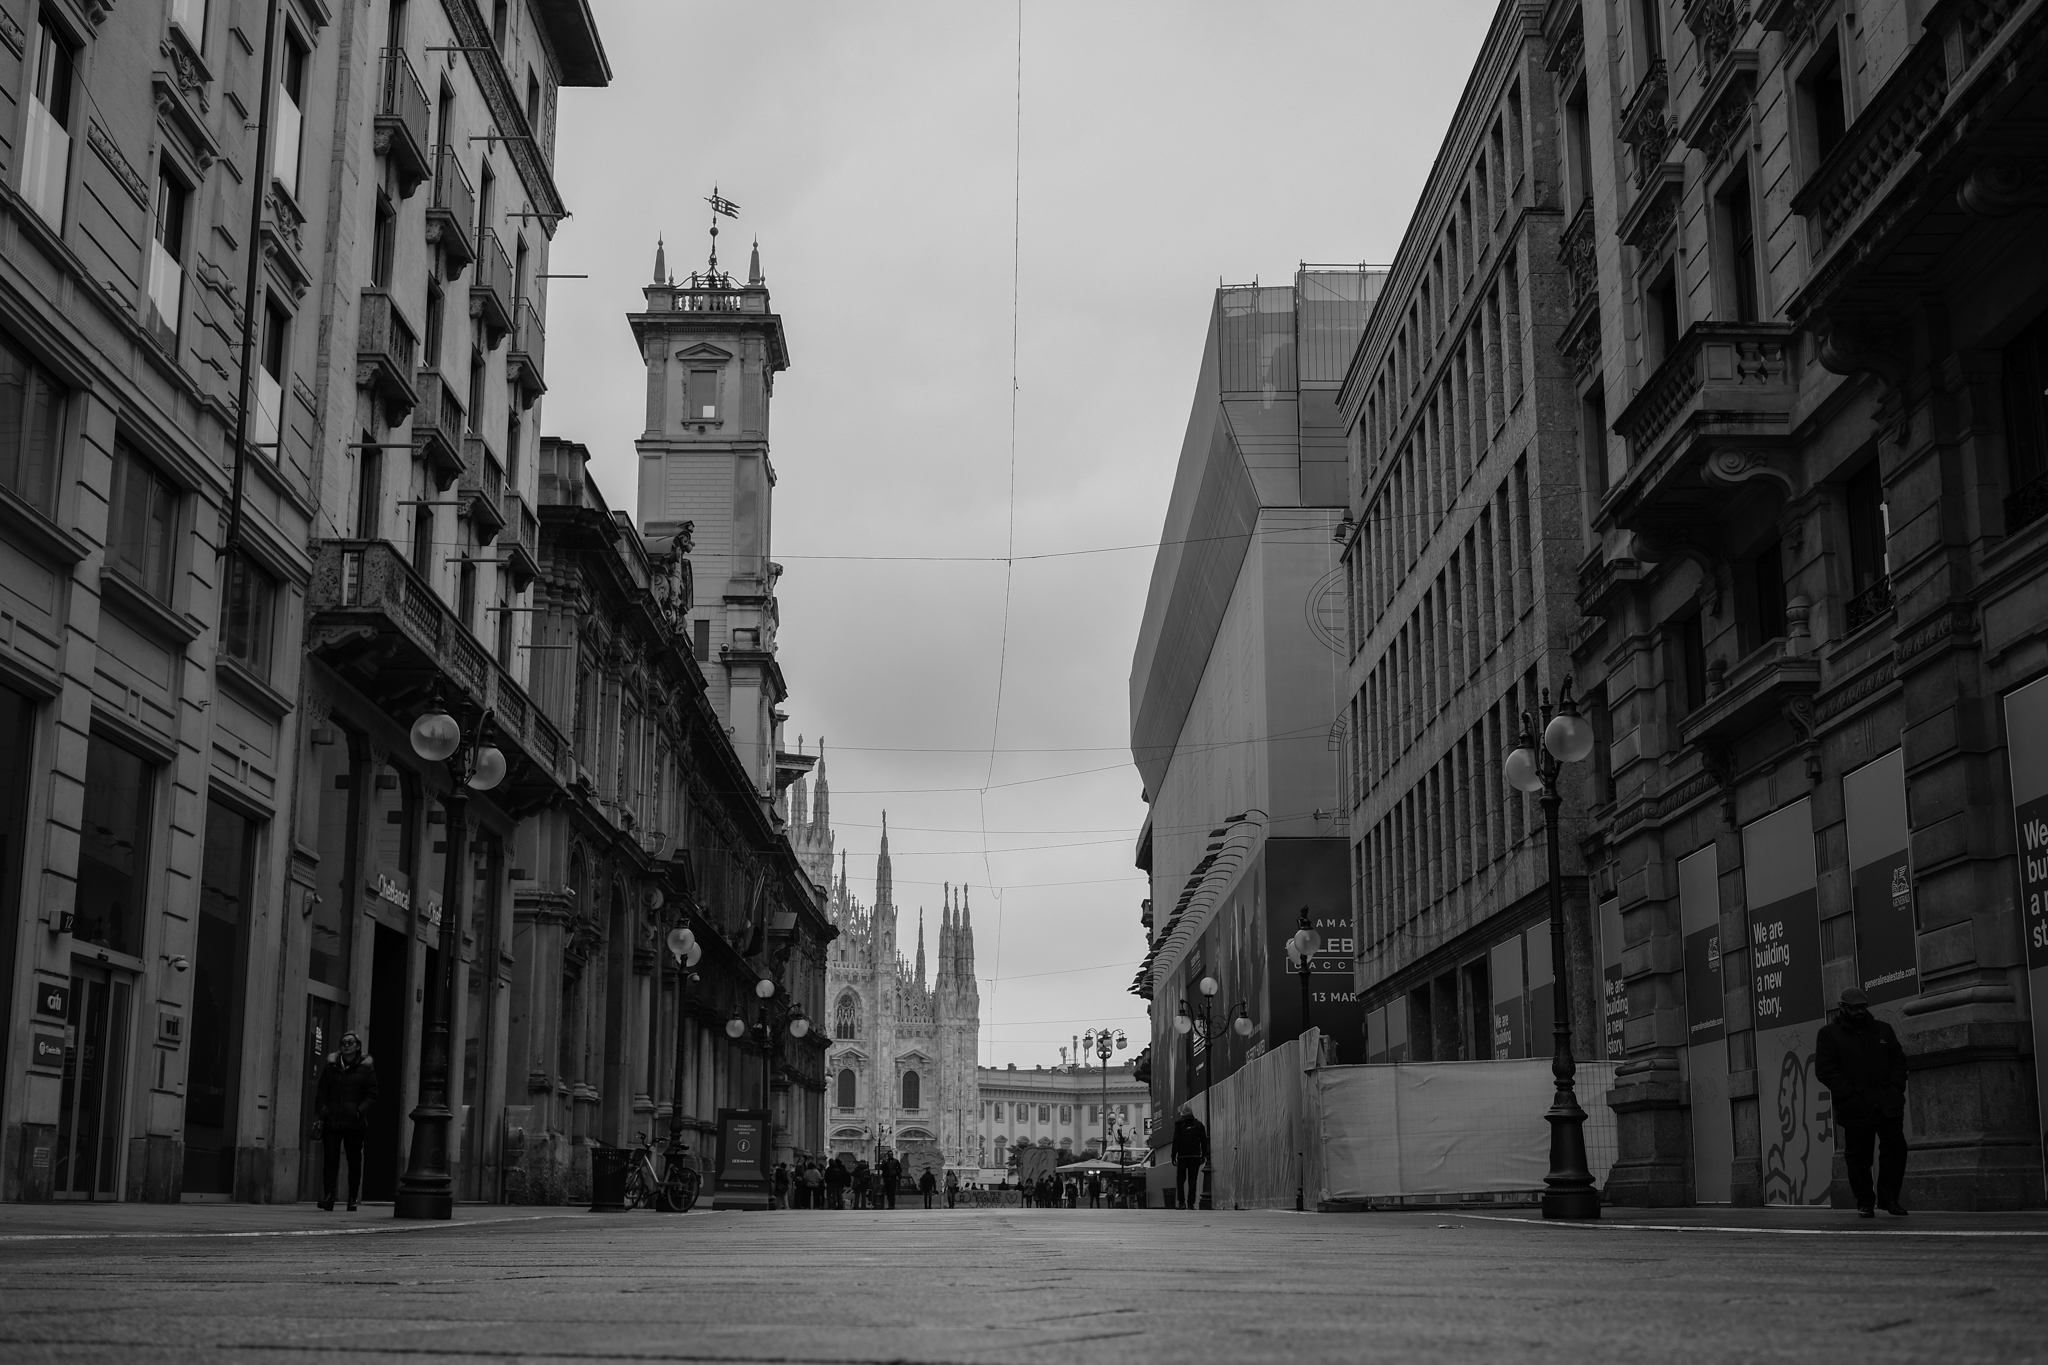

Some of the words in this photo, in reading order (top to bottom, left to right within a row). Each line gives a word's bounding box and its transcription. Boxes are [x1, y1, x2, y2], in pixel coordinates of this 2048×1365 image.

[2027, 850, 2048, 884] bu
[65, 915, 74, 930] 12
[1753, 921, 1768, 945] We
[1769, 920, 1784, 941] are
[1755, 941, 1790, 969] building
[1605, 979, 1614, 998] We
[1614, 978, 1625, 995] are
[1757, 975, 1763, 993] a
[1764, 970, 1783, 991] new
[1864, 967, 1917, 992] generalirealestate.com
[1312, 992, 1326, 1002] 13
[1330, 992, 1360, 1002] MAR
[1606, 995, 1629, 1017] building
[1758, 995, 1783, 1019] story.
[1607, 1022, 1612, 1036] a
[1612, 1018, 1624, 1034] new
[1608, 1038, 1624, 1056] story.
